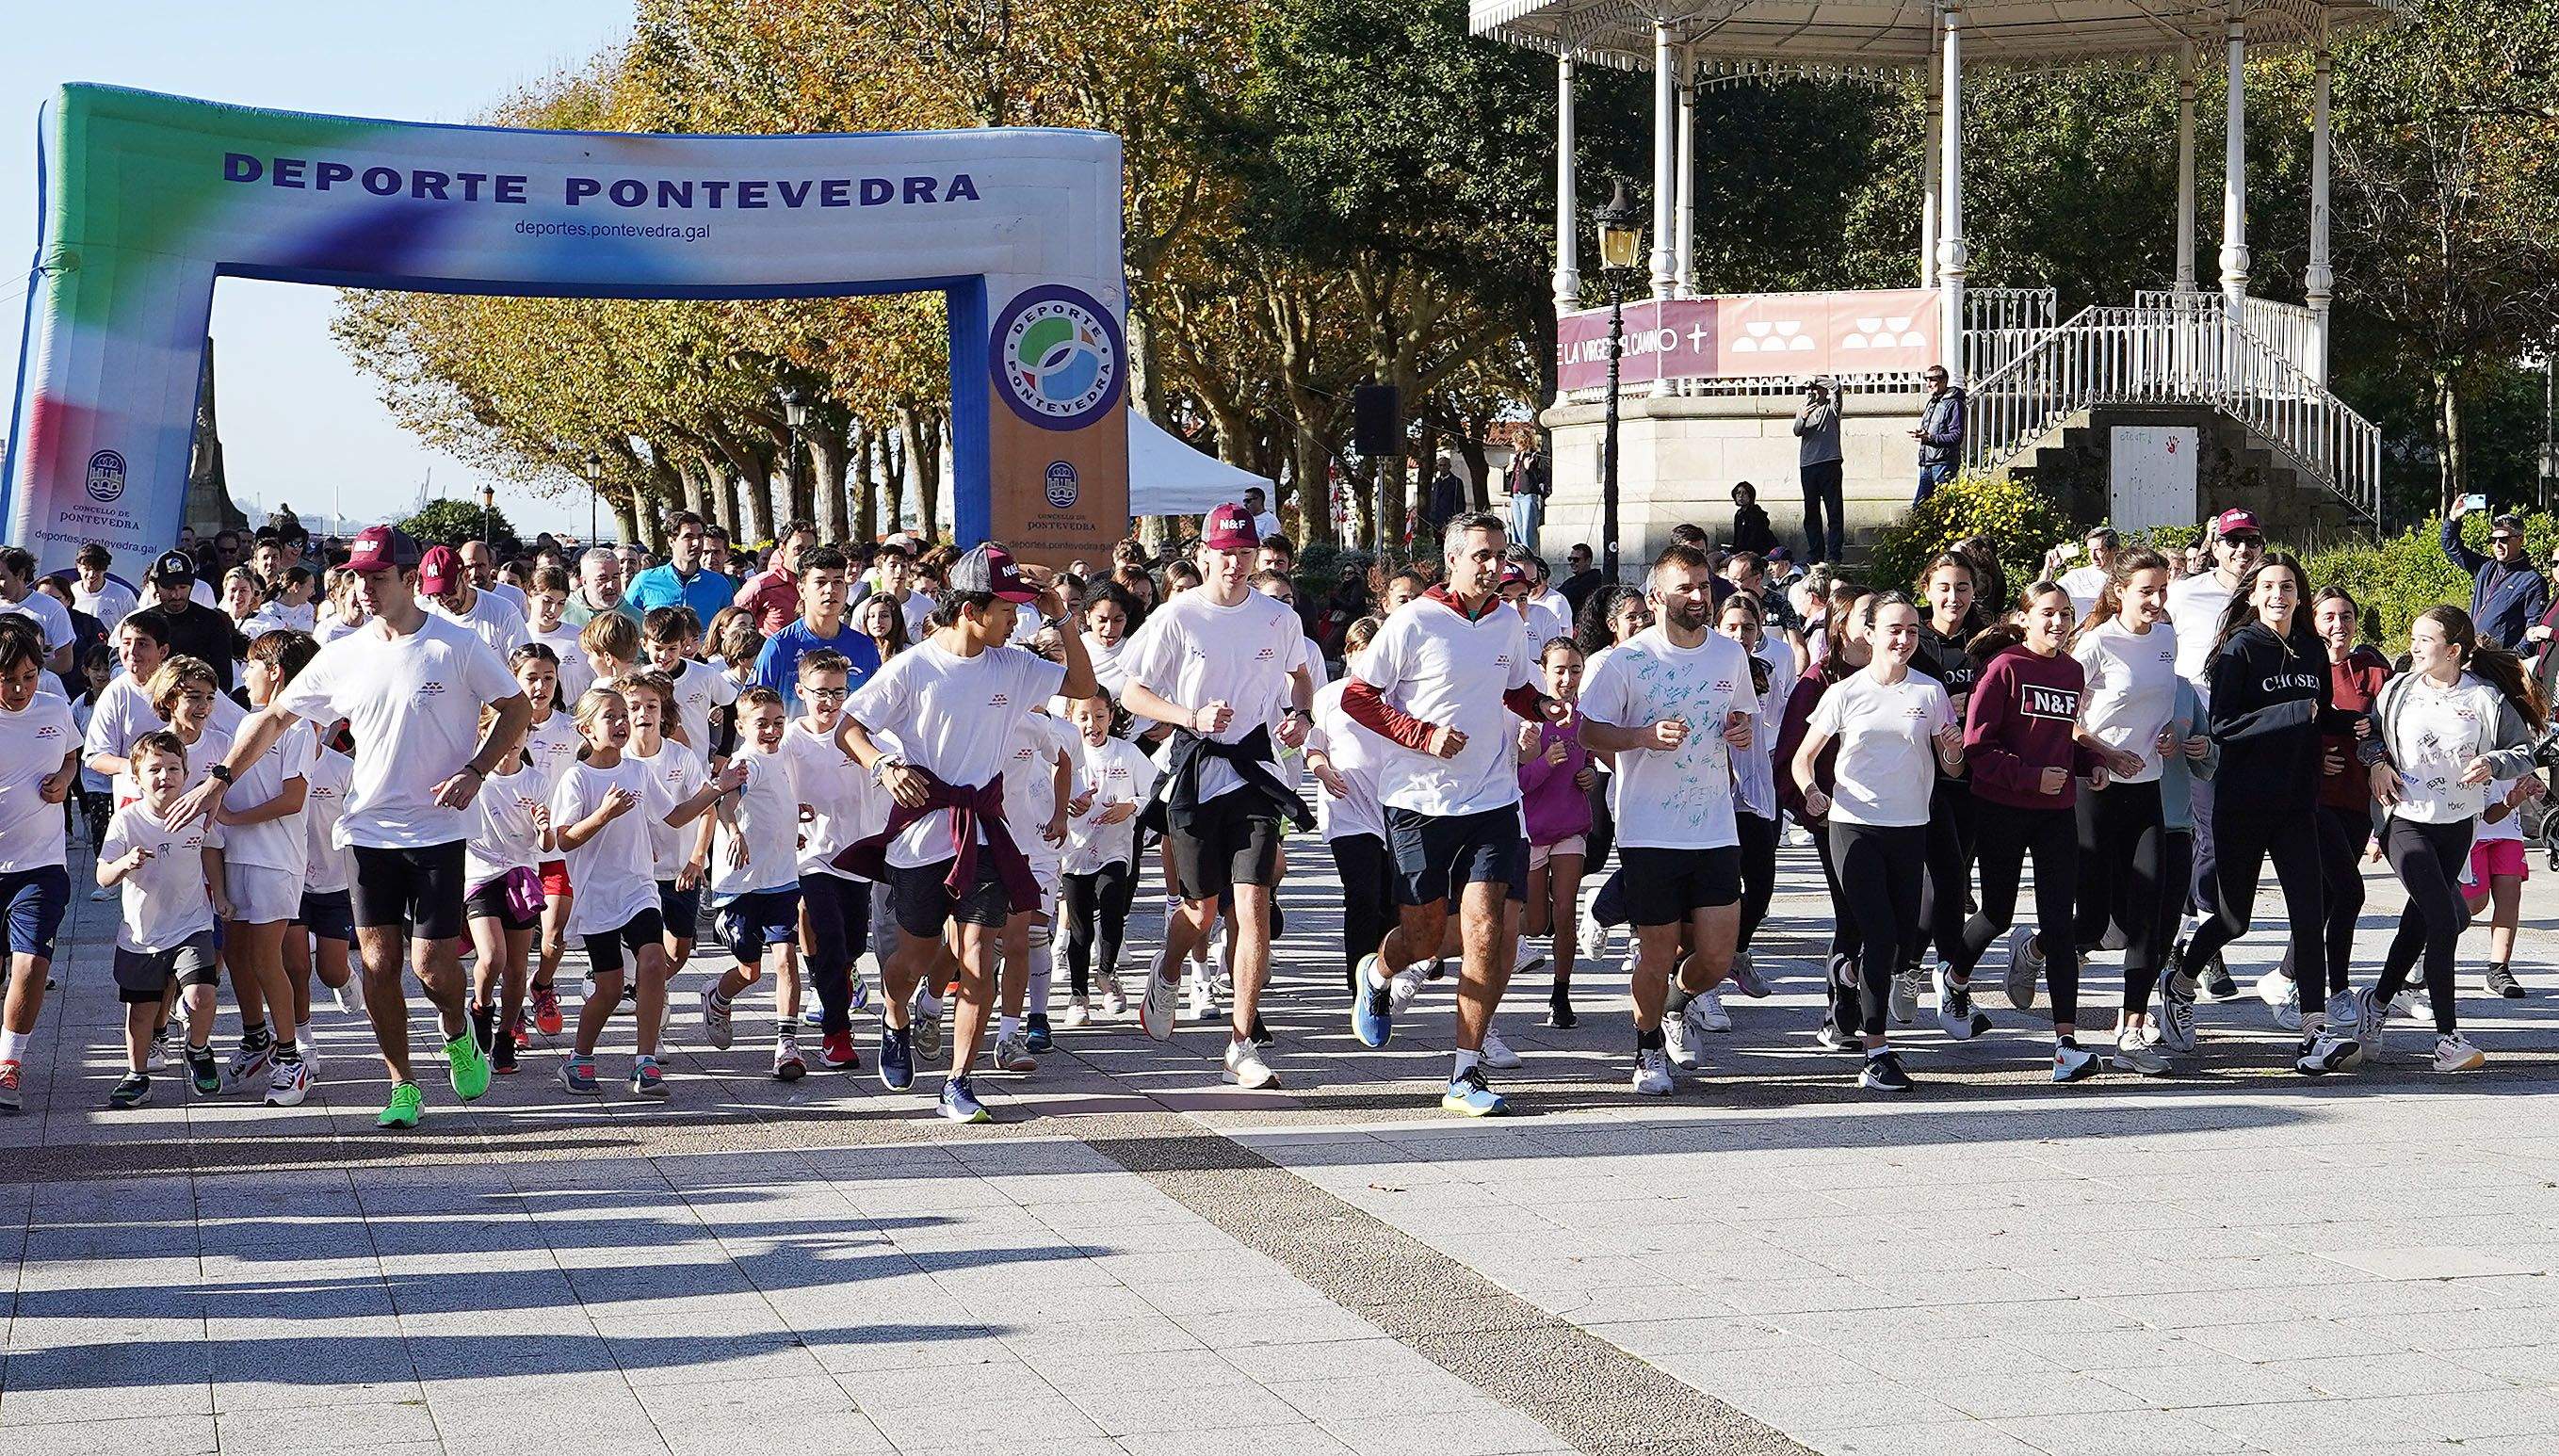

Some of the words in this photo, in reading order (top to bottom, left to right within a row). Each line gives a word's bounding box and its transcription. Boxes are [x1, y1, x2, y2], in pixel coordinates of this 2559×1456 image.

[223, 152, 527, 204] DEPORTE
[564, 173, 980, 209] PONTEVEDRA
[514, 219, 711, 243] deportes.pontevedra.gal
[1012, 304, 1102, 338] DEPORTE
[1564, 342, 1579, 365] LA
[1582, 337, 1612, 363] VIRGE
[1007, 360, 1111, 413] PONTEVEDRA
[59, 511, 140, 530] PONTEVEDRA
[73, 504, 116, 516] CONCELLO
[1027, 521, 1096, 531] PONTEVEDRA
[1219, 518, 1246, 531] N&F
[2033, 690, 2076, 715] N&F
